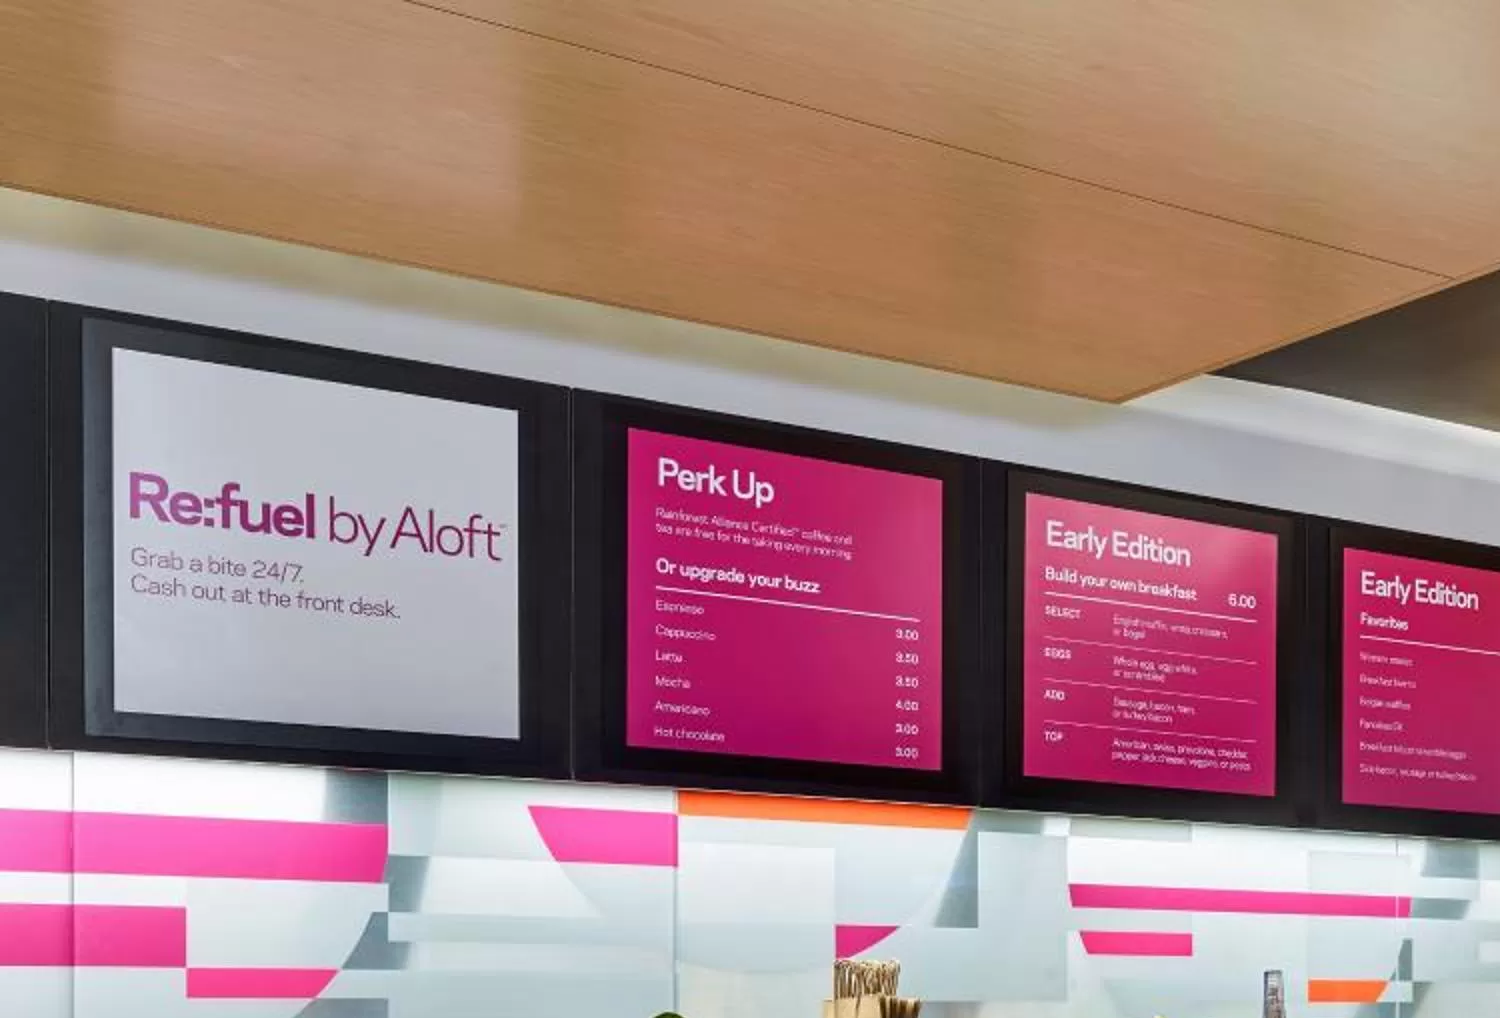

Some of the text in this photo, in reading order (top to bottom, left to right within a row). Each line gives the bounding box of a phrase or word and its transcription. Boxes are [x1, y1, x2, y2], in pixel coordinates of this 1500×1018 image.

[658, 457, 775, 508] Perk Up
[129, 471, 502, 561] Re:fuel by Aloft
[1045, 520, 1191, 567] Early Edition
[131, 547, 304, 583] Grab a bite 24/7.
[656, 557, 821, 594] Or upgrade your buzz
[131, 575, 401, 619] Cash out at the front desk.
[1045, 567, 1257, 609] Build your own breakfast 6.00
[1360, 570, 1479, 611] Early Edition
[1360, 612, 1408, 631] Favorites
